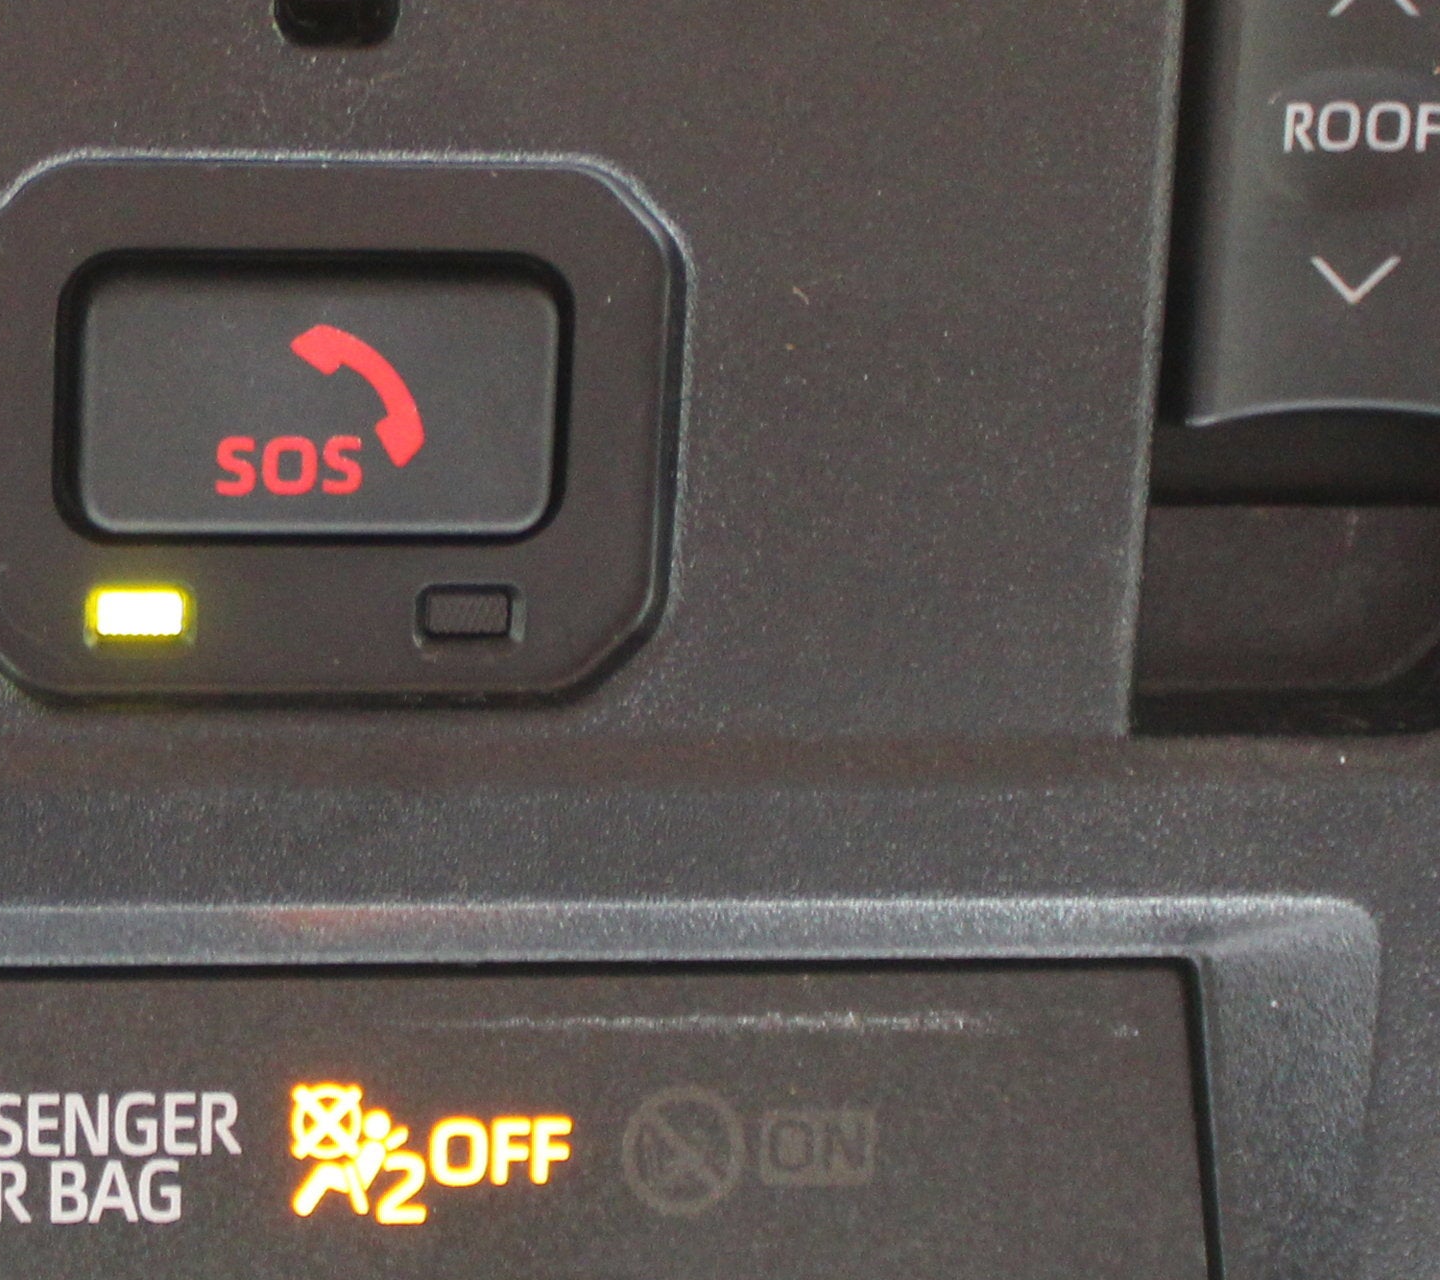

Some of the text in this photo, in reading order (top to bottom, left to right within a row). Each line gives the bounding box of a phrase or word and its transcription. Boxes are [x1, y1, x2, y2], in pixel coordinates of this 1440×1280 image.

[215, 434, 363, 497] SOS
[429, 1115, 572, 1186] OFF
[766, 1116, 869, 1177] ON
[49, 1159, 182, 1224] BAG
